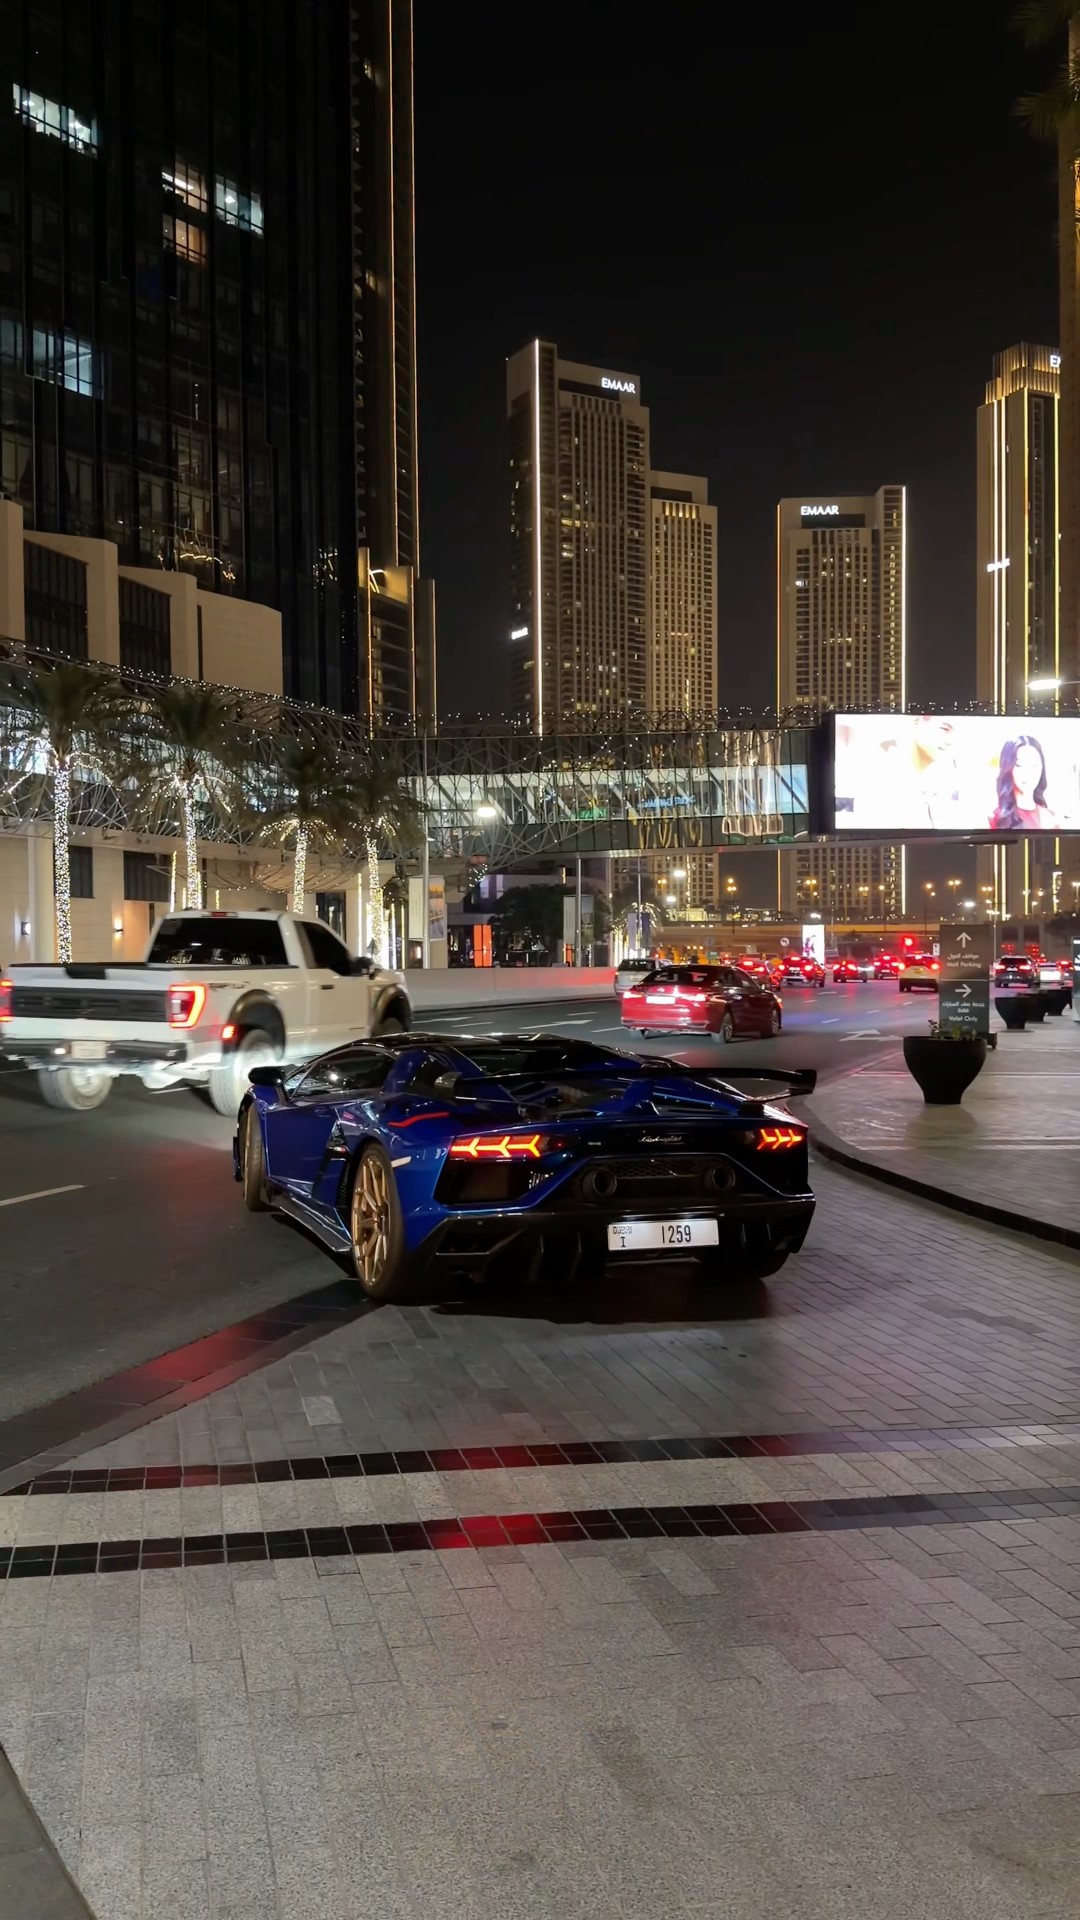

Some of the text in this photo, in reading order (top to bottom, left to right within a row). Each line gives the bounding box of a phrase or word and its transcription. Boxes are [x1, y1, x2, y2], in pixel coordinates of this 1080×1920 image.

[601, 377, 636, 394] EMAAR
[801, 505, 839, 516] EMAAR
[960, 961, 982, 969] Parking
[662, 1225, 692, 1244] 1259
